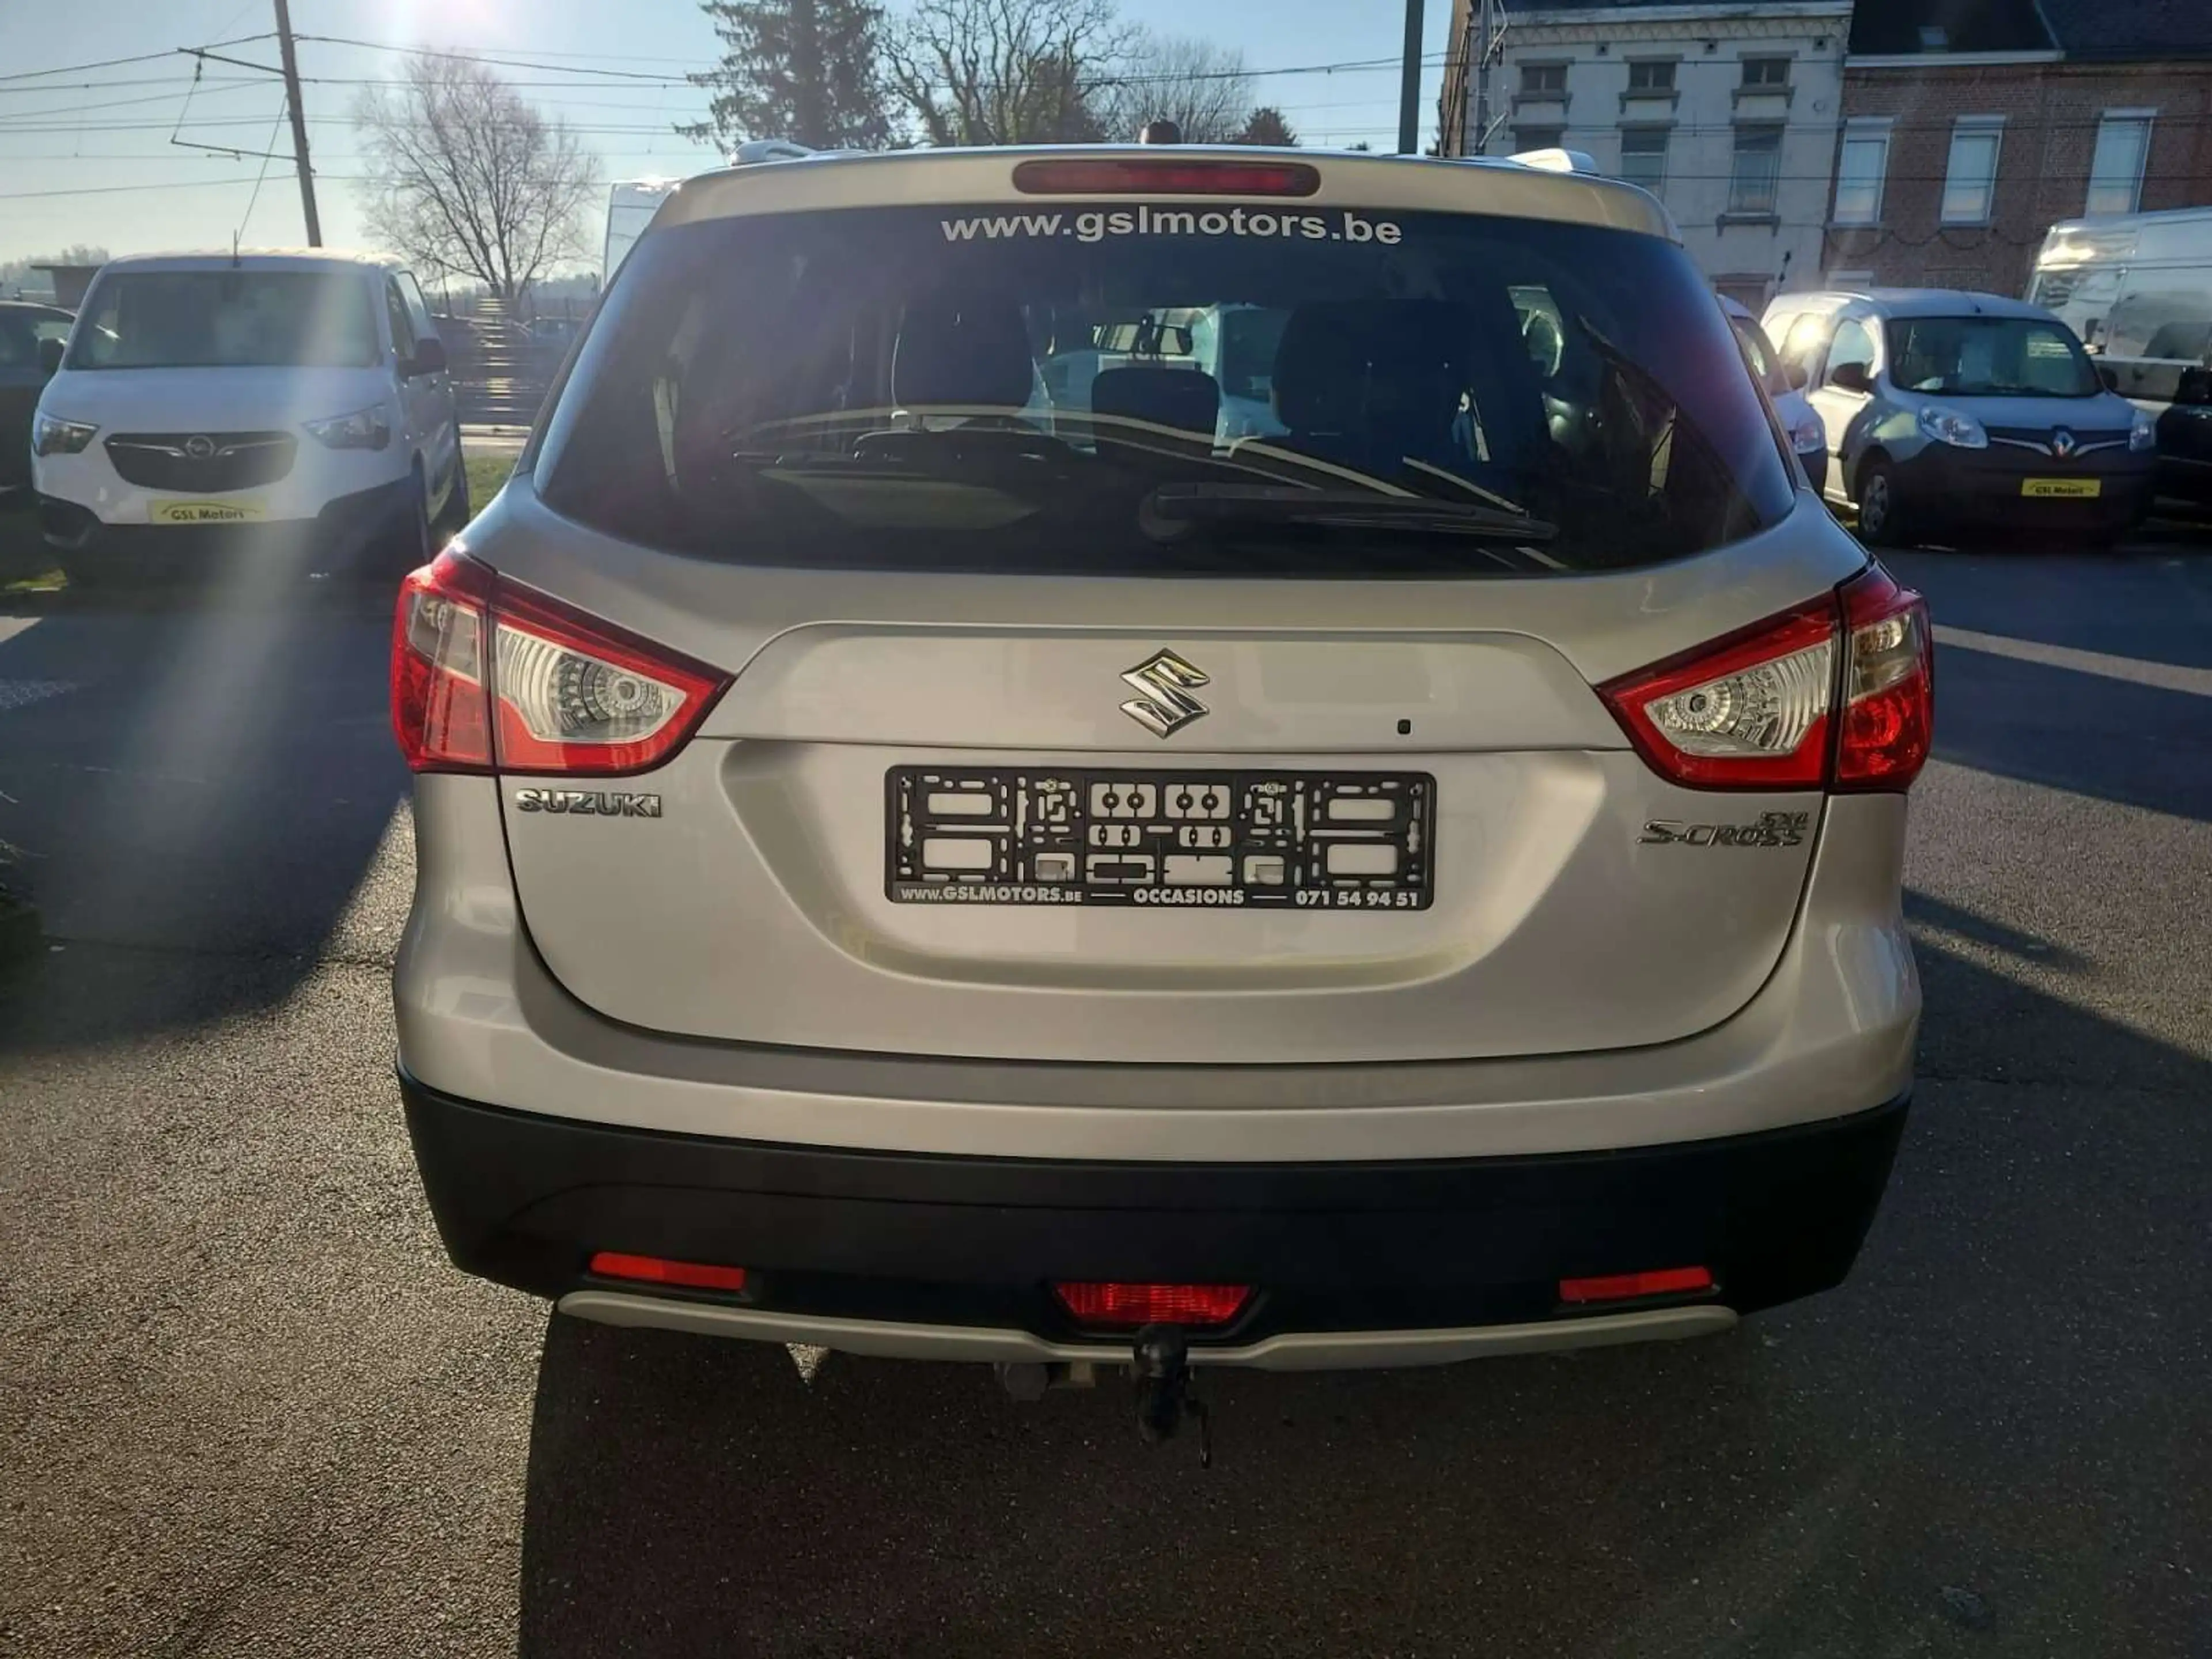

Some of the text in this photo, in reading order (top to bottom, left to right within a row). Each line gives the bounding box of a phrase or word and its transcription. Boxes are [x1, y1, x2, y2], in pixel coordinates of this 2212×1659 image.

[940, 206, 1402, 244] www.gslmotors.be
[516, 789, 662, 817] SUZUKI
[1133, 888, 1245, 904] OCCASIONS
[1296, 891, 1331, 905] 071
[1337, 891, 1361, 905] 54
[1366, 892, 1391, 906] 94
[1396, 892, 1418, 906] 51
